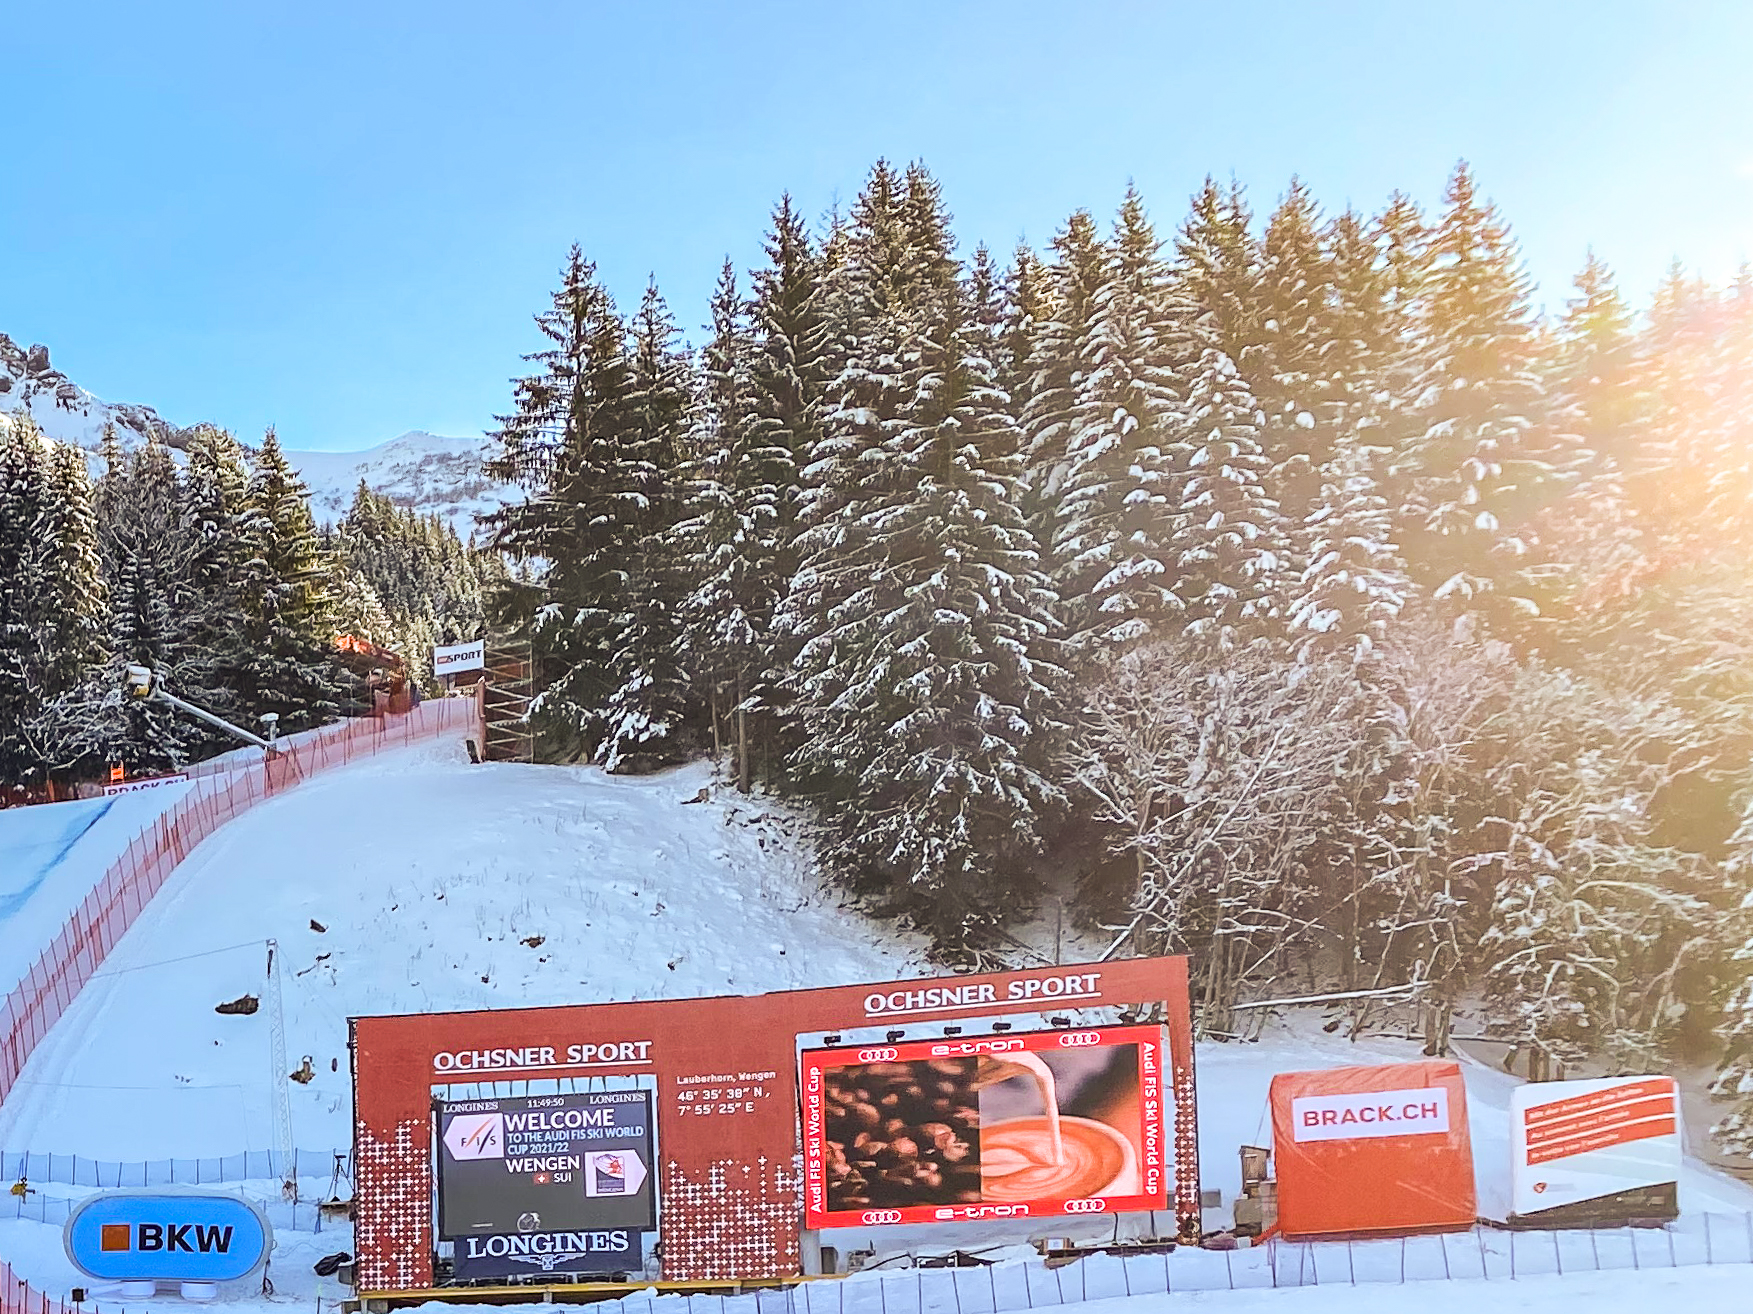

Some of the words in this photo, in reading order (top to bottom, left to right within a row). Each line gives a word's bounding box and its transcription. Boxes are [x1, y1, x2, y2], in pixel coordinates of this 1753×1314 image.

[448, 650, 482, 663] SPORT
[864, 983, 997, 1012] OCHSNER
[1008, 974, 1101, 1000] SPORT
[434, 1046, 556, 1070] OCHSNER
[567, 1041, 652, 1063] SPORT
[932, 1039, 1024, 1056] e-tron
[1144, 1042, 1155, 1074] Audi
[738, 1071, 776, 1081] Wengen
[807, 1066, 821, 1092] Cup
[1145, 1077, 1157, 1098] FIS
[443, 1101, 499, 1113] LONGINES
[589, 1092, 646, 1105] LONGINES
[1146, 1100, 1158, 1121] Ski
[504, 1108, 615, 1131] WELCOME
[808, 1095, 820, 1136] World
[1303, 1102, 1439, 1127] BRACK.CH
[507, 1133, 521, 1143] TO
[523, 1132, 541, 1142] THE
[541, 1130, 570, 1141] AUDI
[571, 1129, 586, 1139] FIS
[587, 1127, 603, 1138] SKI
[605, 1126, 643, 1137] WORLD
[1146, 1123, 1159, 1165] World
[508, 1144, 527, 1155] CUP
[529, 1142, 569, 1154] 2021/22
[808, 1137, 821, 1157] Ski
[505, 1155, 580, 1173] WENGEN
[809, 1160, 822, 1180] FIS
[553, 1172, 572, 1182] SUI
[1146, 1168, 1160, 1195] Cup
[809, 1182, 822, 1213] Audi
[936, 1203, 1028, 1220] e-tron
[138, 1223, 234, 1253] BKW
[466, 1230, 629, 1259] LONGINES
